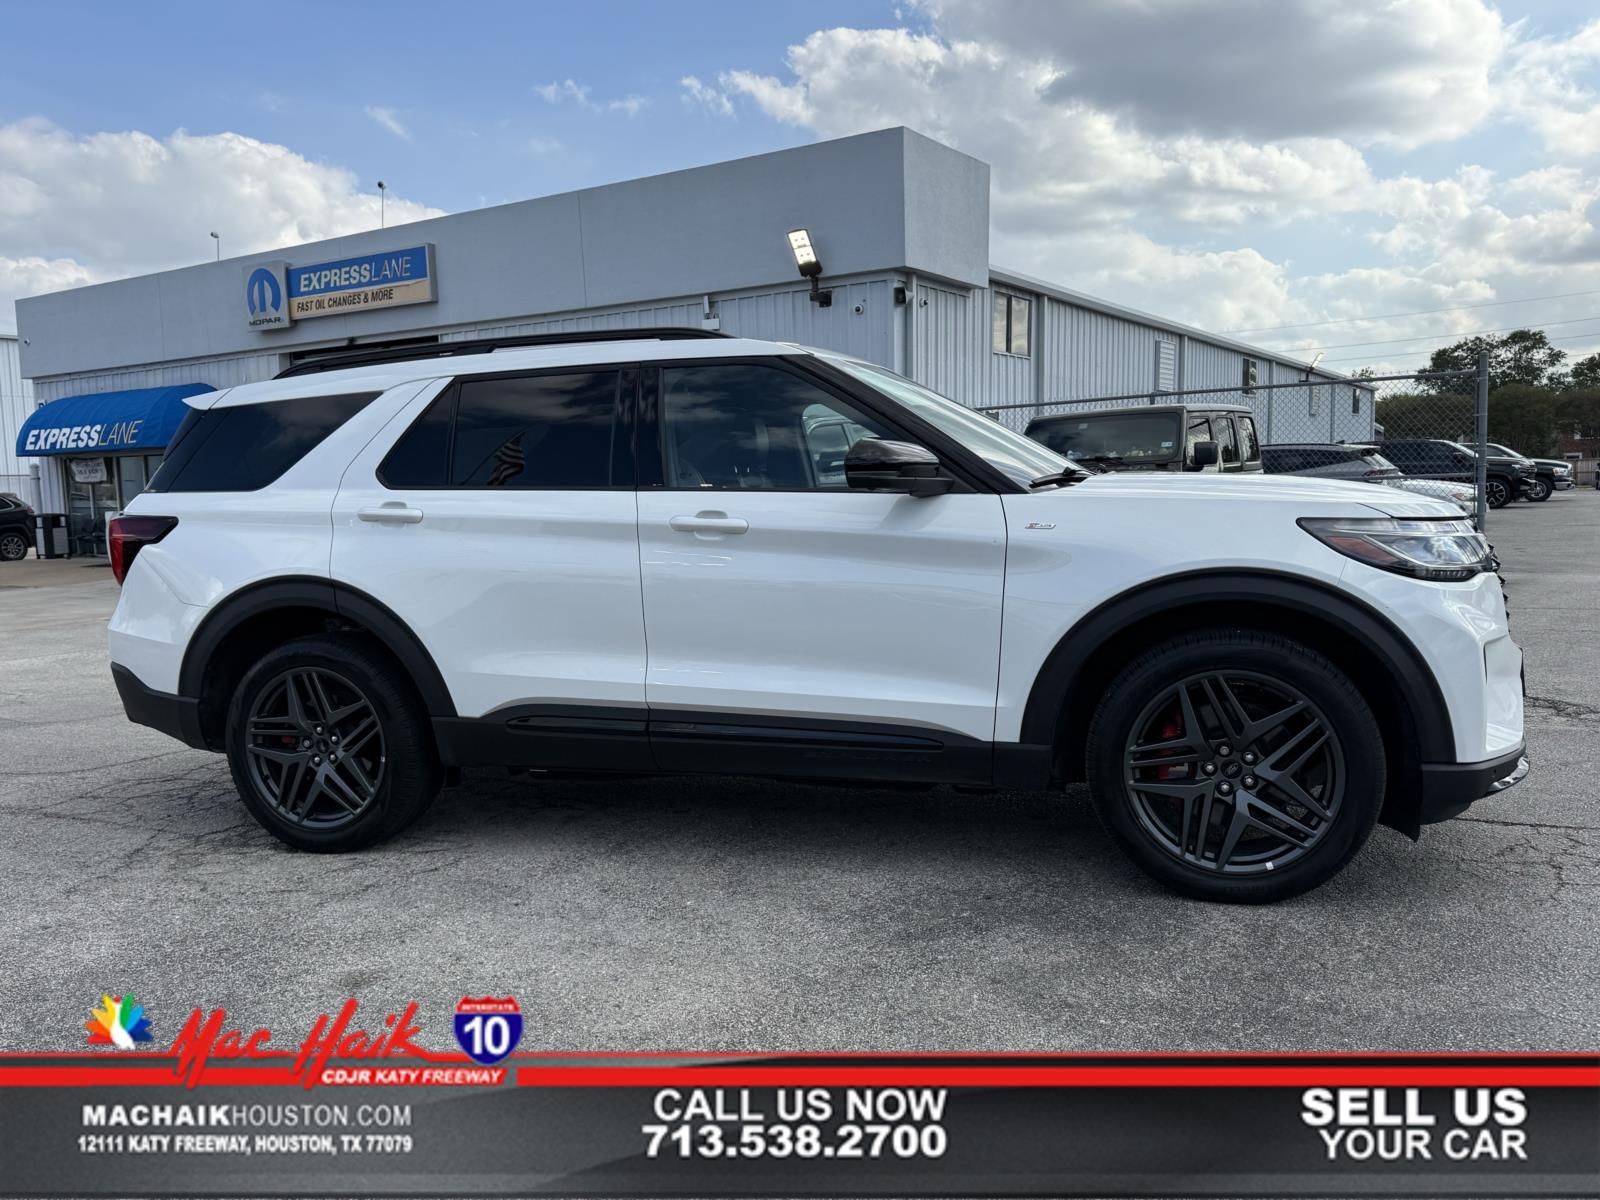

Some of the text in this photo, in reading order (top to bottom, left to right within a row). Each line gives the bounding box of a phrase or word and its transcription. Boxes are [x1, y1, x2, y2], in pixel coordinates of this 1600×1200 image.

[297, 289, 393, 312] FAST OIL CHANGES & MORE
[249, 317, 281, 327] MOPAR
